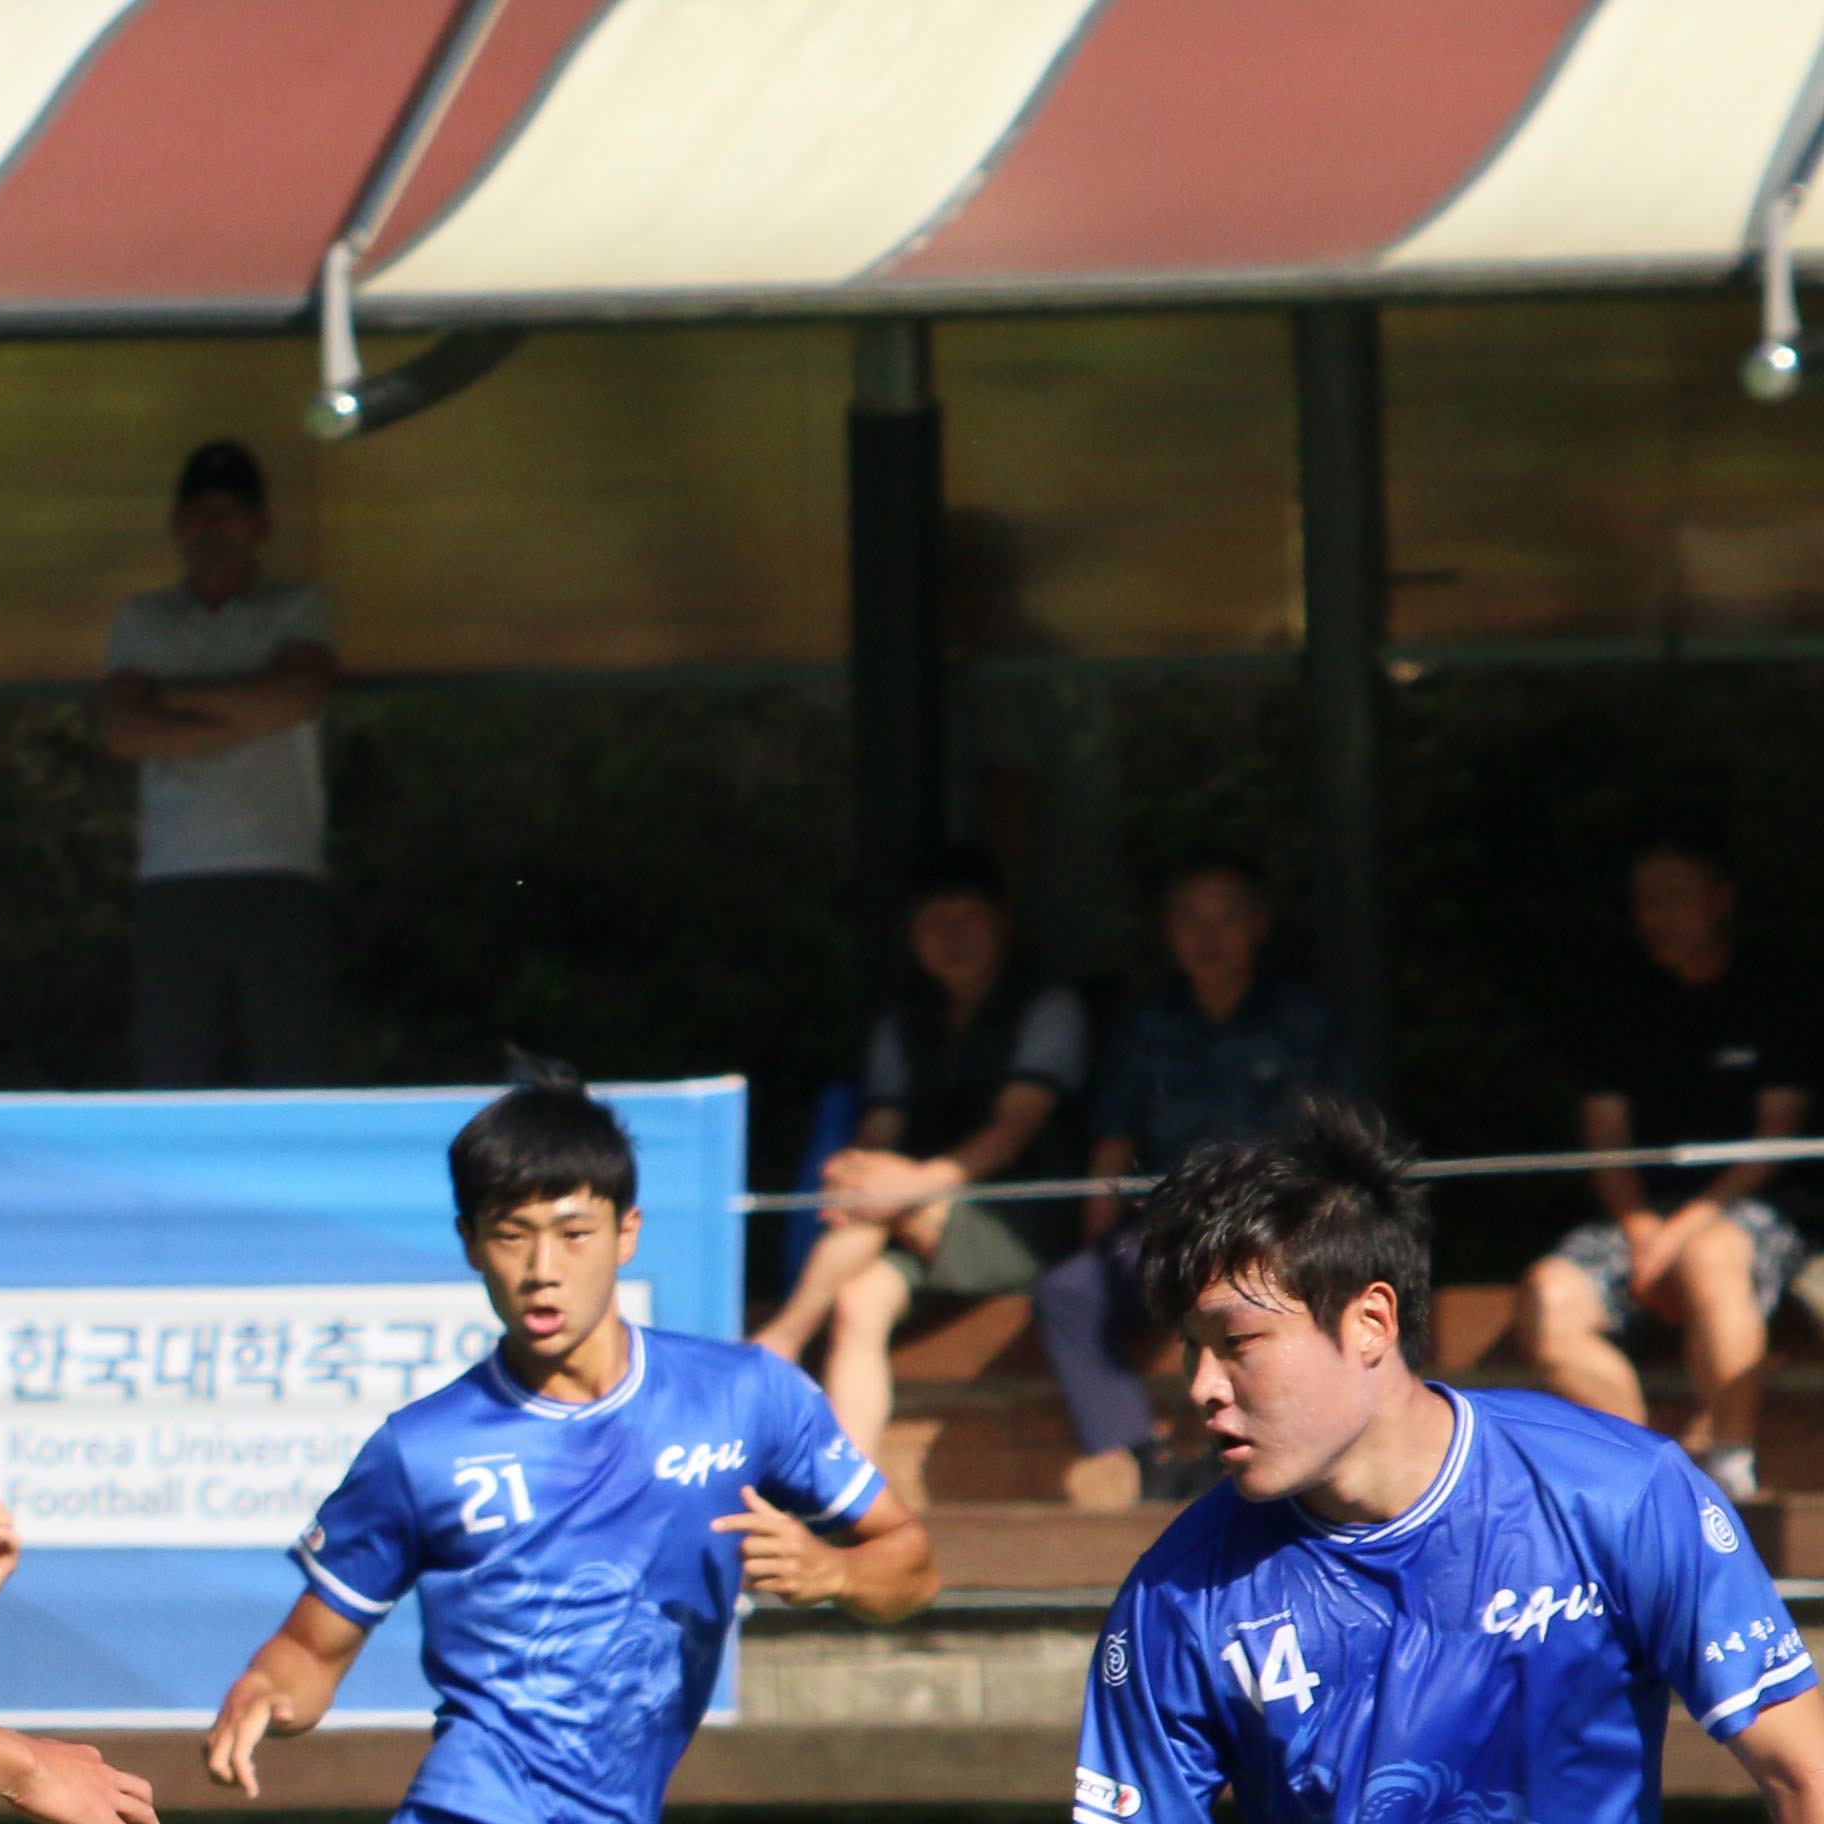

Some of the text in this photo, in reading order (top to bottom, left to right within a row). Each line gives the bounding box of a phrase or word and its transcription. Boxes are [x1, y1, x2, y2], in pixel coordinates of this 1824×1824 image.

[6, 1319, 499, 1402] 한국대학축구
[7, 1424, 361, 1468] Korea Universit
[453, 1462, 535, 1535] 21
[1220, 1622, 1322, 1716] 14
